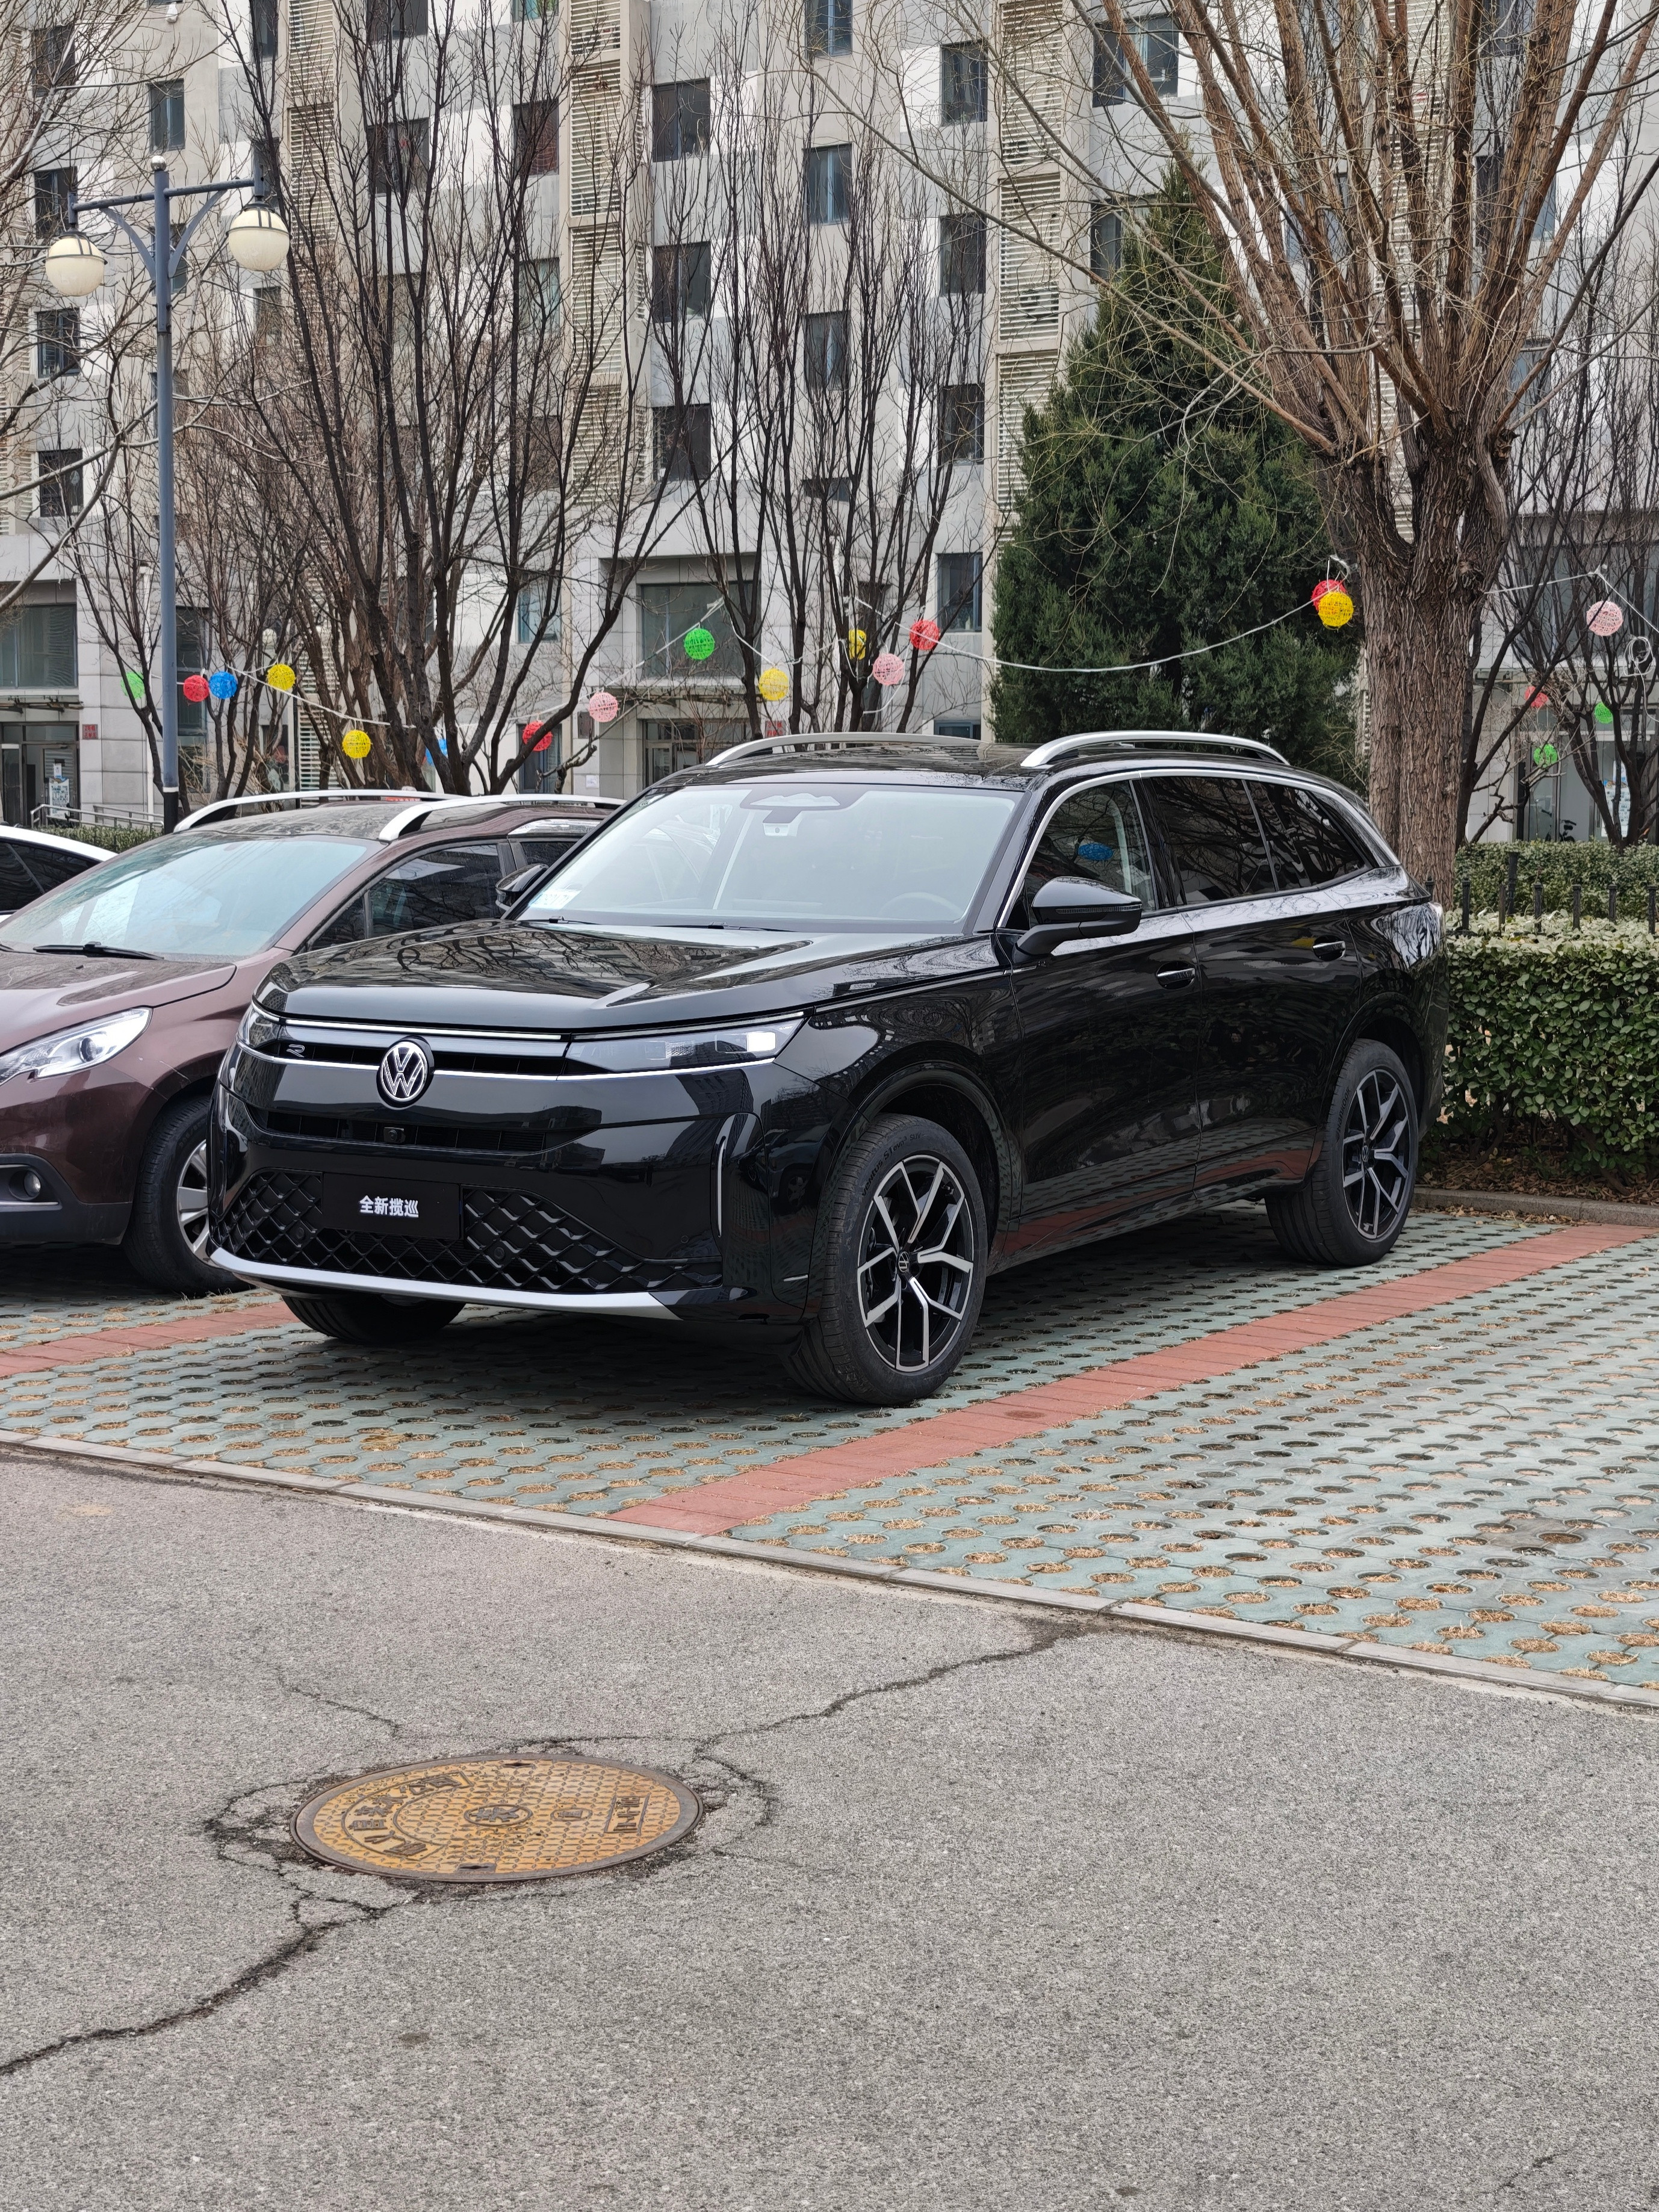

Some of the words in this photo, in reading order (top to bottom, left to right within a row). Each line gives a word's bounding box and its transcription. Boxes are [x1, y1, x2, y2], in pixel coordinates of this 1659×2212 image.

[381, 1042, 426, 1101] VW
[359, 1195, 419, 1218] 全新揽巡
